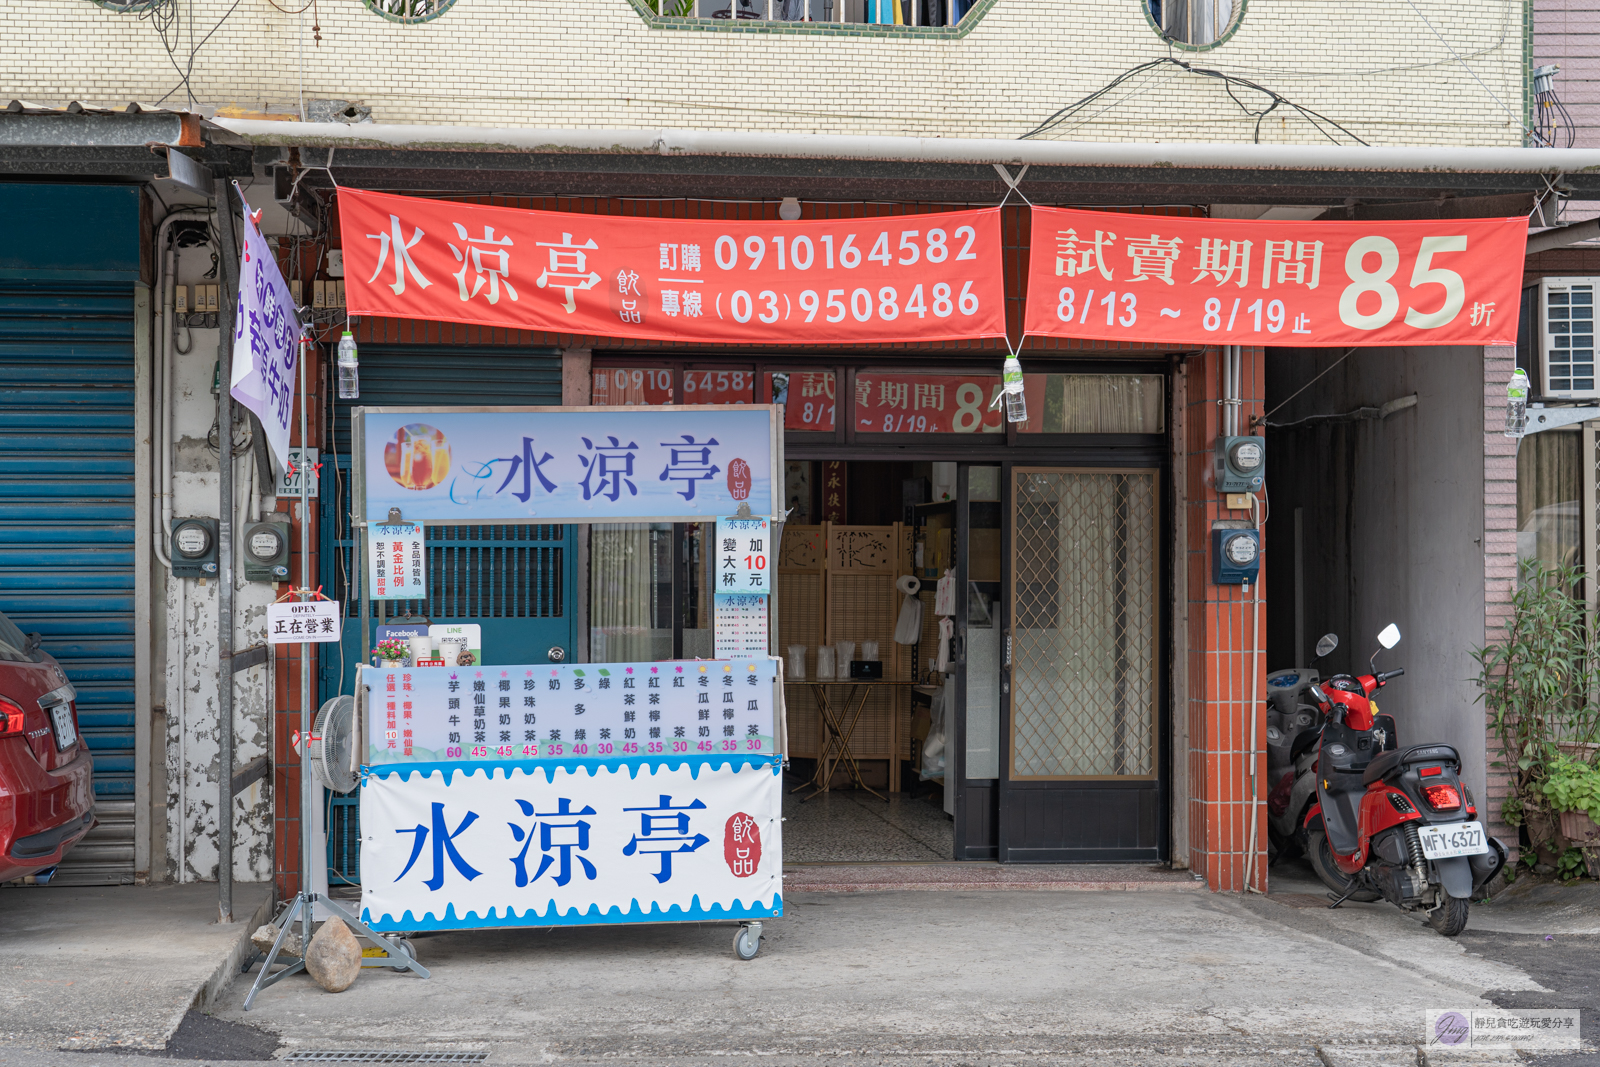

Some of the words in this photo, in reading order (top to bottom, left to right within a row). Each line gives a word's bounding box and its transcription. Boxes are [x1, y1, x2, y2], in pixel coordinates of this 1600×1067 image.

[366, 214, 602, 315] 水涼亭
[659, 243, 702, 272] 訂購
[714, 225, 977, 271] 0910164582
[1055, 228, 1326, 290] 試賣期間
[616, 269, 642, 324] 飲品
[660, 290, 703, 318] 專線
[715, 281, 979, 324] (03)9508486
[1056, 287, 1138, 328] 8/13
[496, 434, 721, 503] 水涼亭
[731, 461, 748, 500] 飲品
[392, 541, 405, 587] 黃金比例
[723, 538, 737, 587] 變大杯
[273, 617, 334, 634] 正在營業
[291, 605, 316, 613] OPEN
[448, 681, 460, 744] 芋頭牛奶
[473, 680, 486, 743] 嫩仙草奶茶
[499, 680, 511, 742] 椰果奶茶
[524, 679, 536, 741] 珍珠奶茶
[574, 678, 587, 740] 多多綠
[623, 677, 636, 739] 紅茶鮮奶
[648, 677, 661, 738] 紅茶檸檬
[698, 676, 710, 737] 冬瓜鮮奶
[722, 675, 734, 737] 冬瓜檸檬
[747, 675, 759, 736] 冬瓜茶
[446, 747, 462, 758] 60
[472, 746, 487, 757] 45
[497, 746, 512, 756] 45
[522, 745, 538, 756] 45
[547, 744, 563, 755] 35
[572, 744, 588, 755] 40
[598, 743, 613, 754] 30
[622, 742, 638, 753] 45
[647, 742, 663, 753] 35
[672, 741, 688, 752] 30
[697, 740, 712, 751] 45
[722, 740, 737, 751] 35
[746, 739, 761, 750] 30
[393, 794, 710, 892] 水涼亭
[731, 816, 756, 876] 飲品
